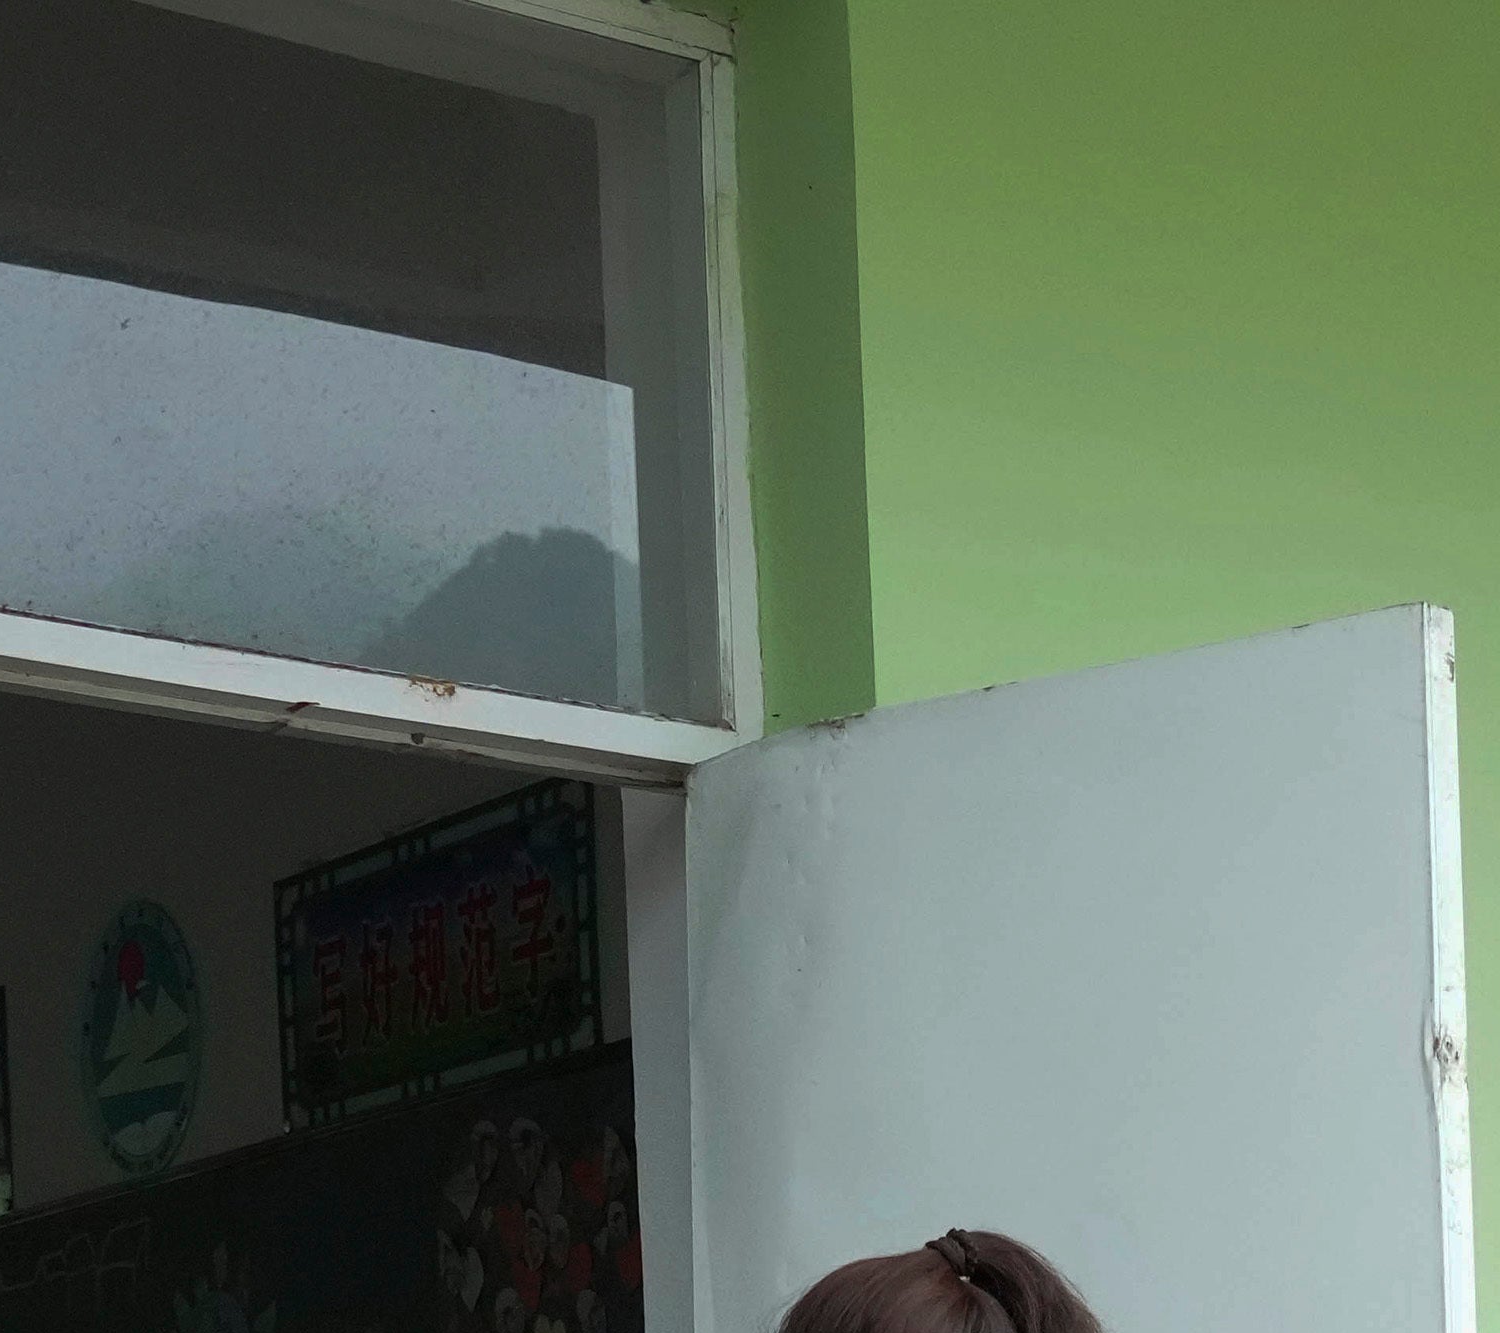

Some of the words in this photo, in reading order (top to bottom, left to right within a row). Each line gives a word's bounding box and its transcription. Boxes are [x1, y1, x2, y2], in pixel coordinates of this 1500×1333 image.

[314, 868, 554, 1055] 写好规范字
